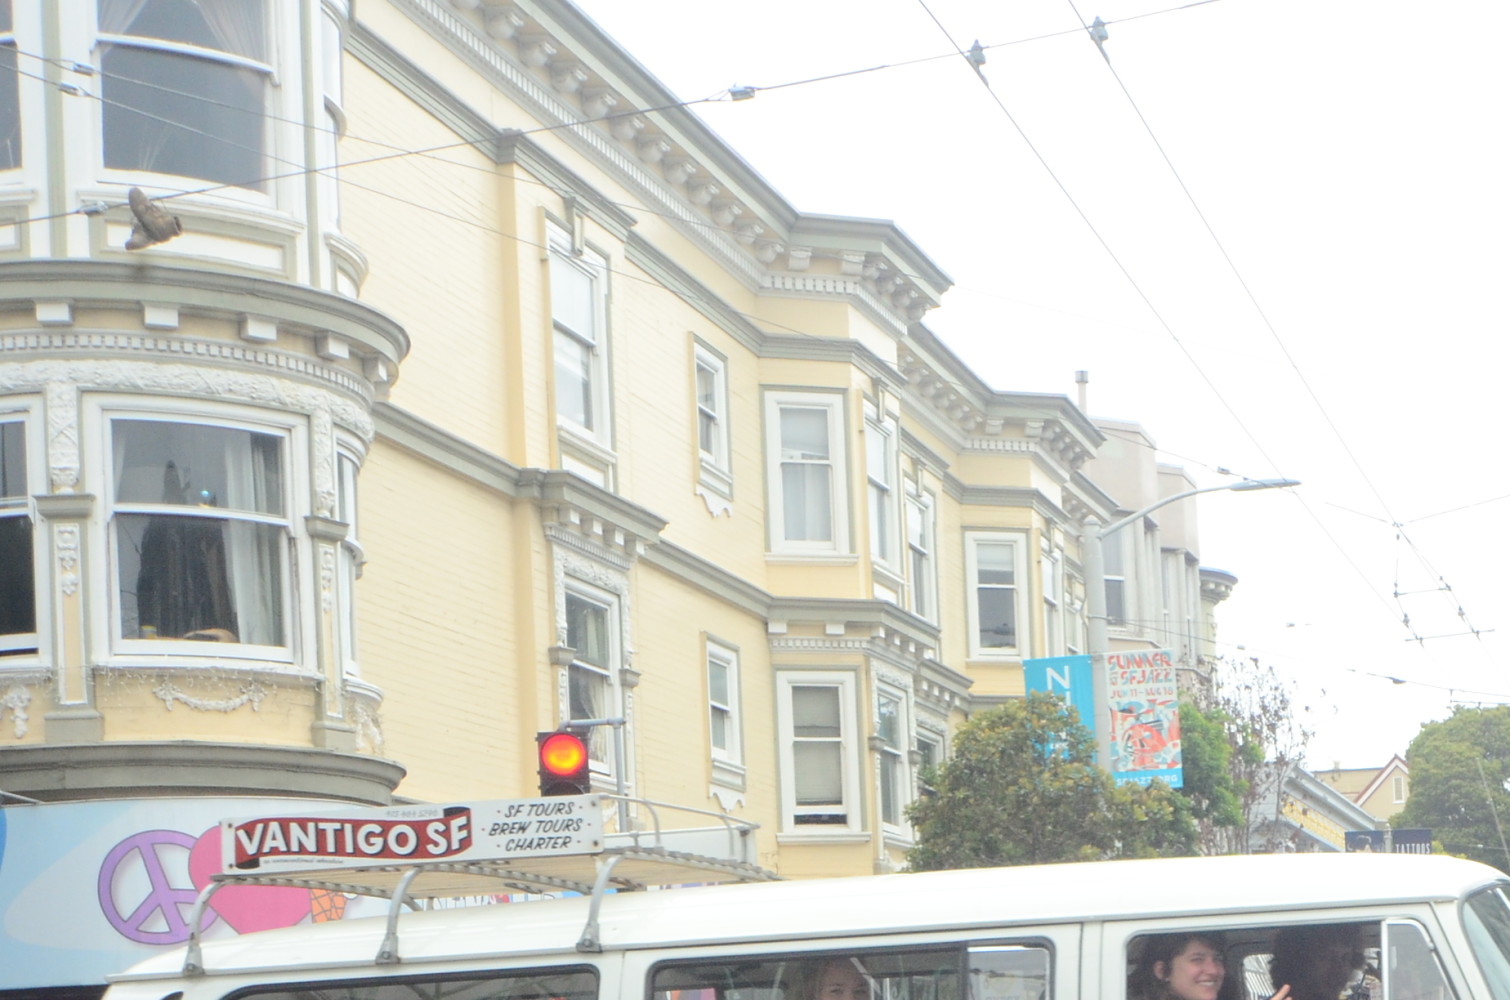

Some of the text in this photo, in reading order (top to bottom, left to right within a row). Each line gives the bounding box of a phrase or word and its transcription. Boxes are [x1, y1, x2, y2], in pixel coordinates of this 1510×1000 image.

[1107, 652, 1173, 671] SUMMER
[1120, 668, 1172, 685] SFJAZZ
[504, 802, 575, 818] SF TOURS
[236, 815, 469, 856] VANTIGO SF
[488, 818, 584, 836] BREW TOURS
[504, 836, 572, 852] CHARTER
[1395, 843, 1431, 854] TATTOOS
